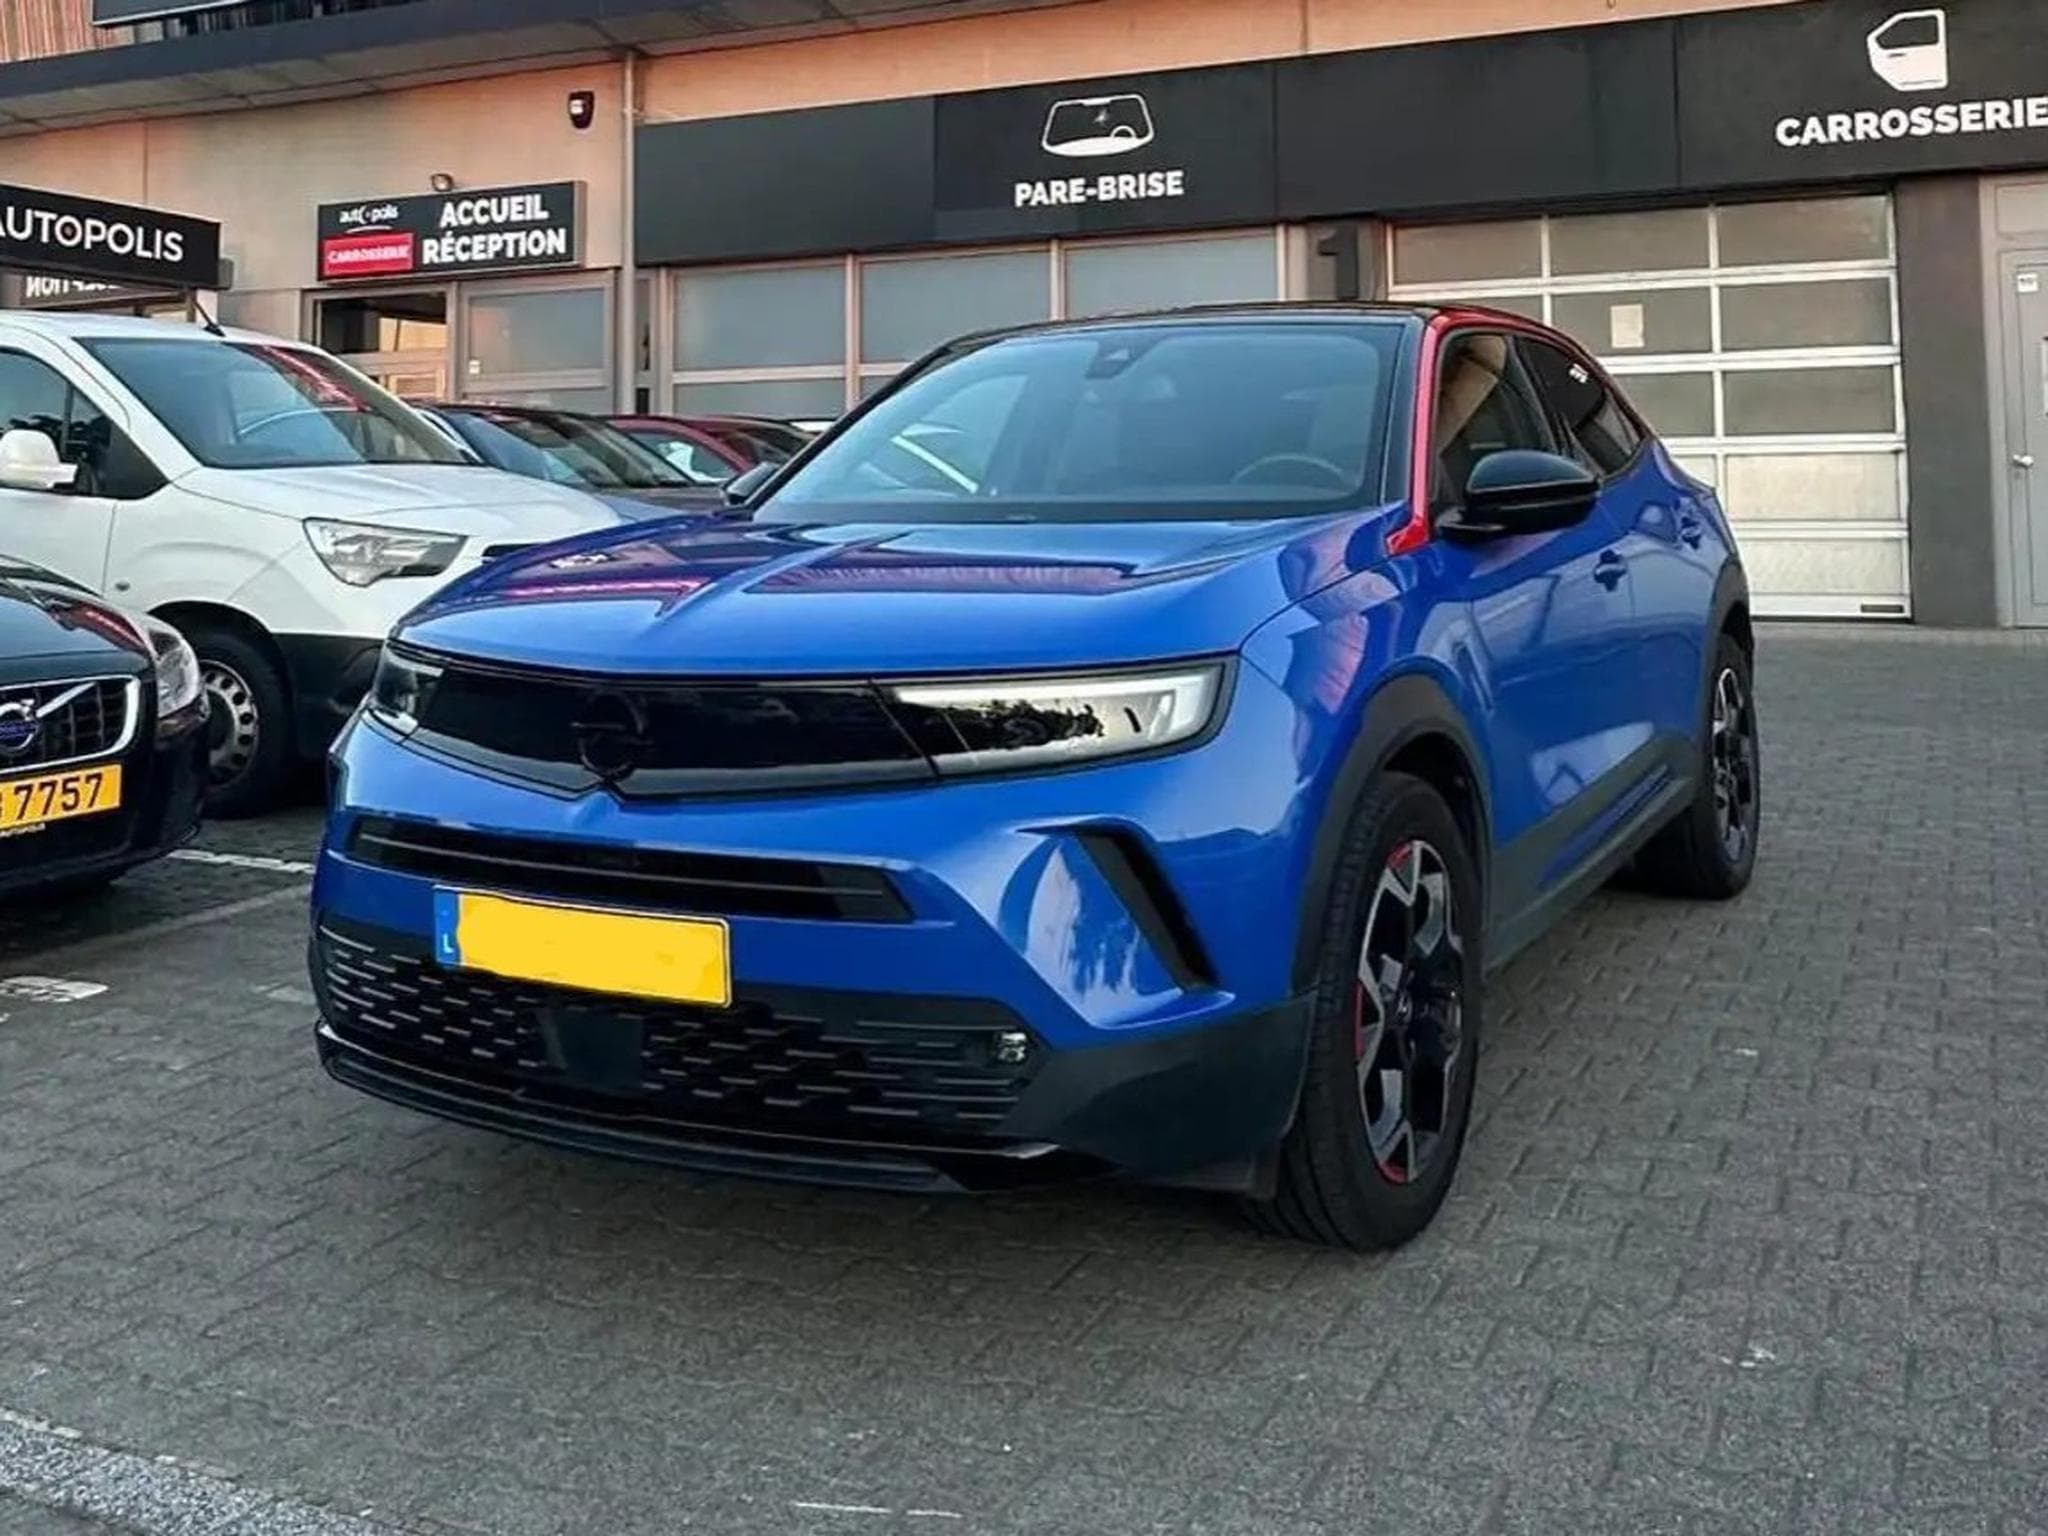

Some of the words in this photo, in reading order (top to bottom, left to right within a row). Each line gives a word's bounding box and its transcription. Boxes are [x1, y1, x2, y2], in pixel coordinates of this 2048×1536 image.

[1775, 96, 2048, 147] CARROSSERIE
[1014, 170, 1184, 207] PARE-BRISE
[440, 194, 549, 228] ACCUEIL
[0, 205, 184, 262] UTOPOLIS
[422, 231, 567, 264] RÉCEPTION
[14, 772, 103, 821] 7757
